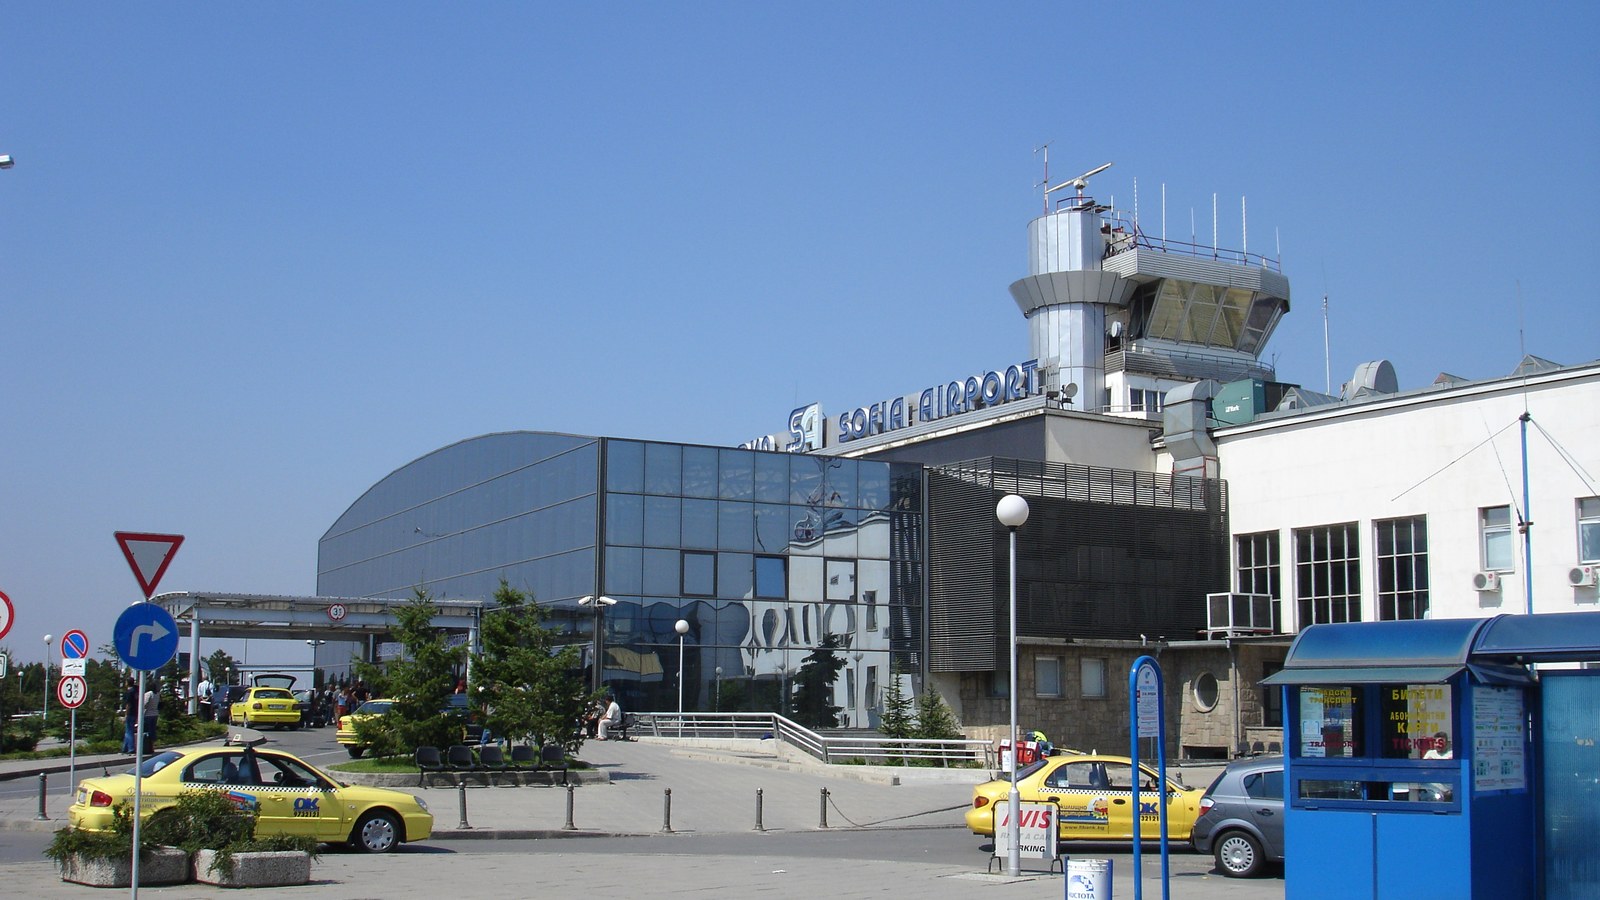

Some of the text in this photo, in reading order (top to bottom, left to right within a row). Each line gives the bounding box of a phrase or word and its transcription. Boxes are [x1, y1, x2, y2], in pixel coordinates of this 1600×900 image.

[839, 359, 1040, 443] SOFIA AIRPORT
[66, 684, 73, 698] 3
[1392, 688, 1443, 700] БИЛЕТИ
[1392, 738, 1445, 750] TICKETS
[294, 797, 320, 810] OK
[1019, 844, 1046, 853] RKING
